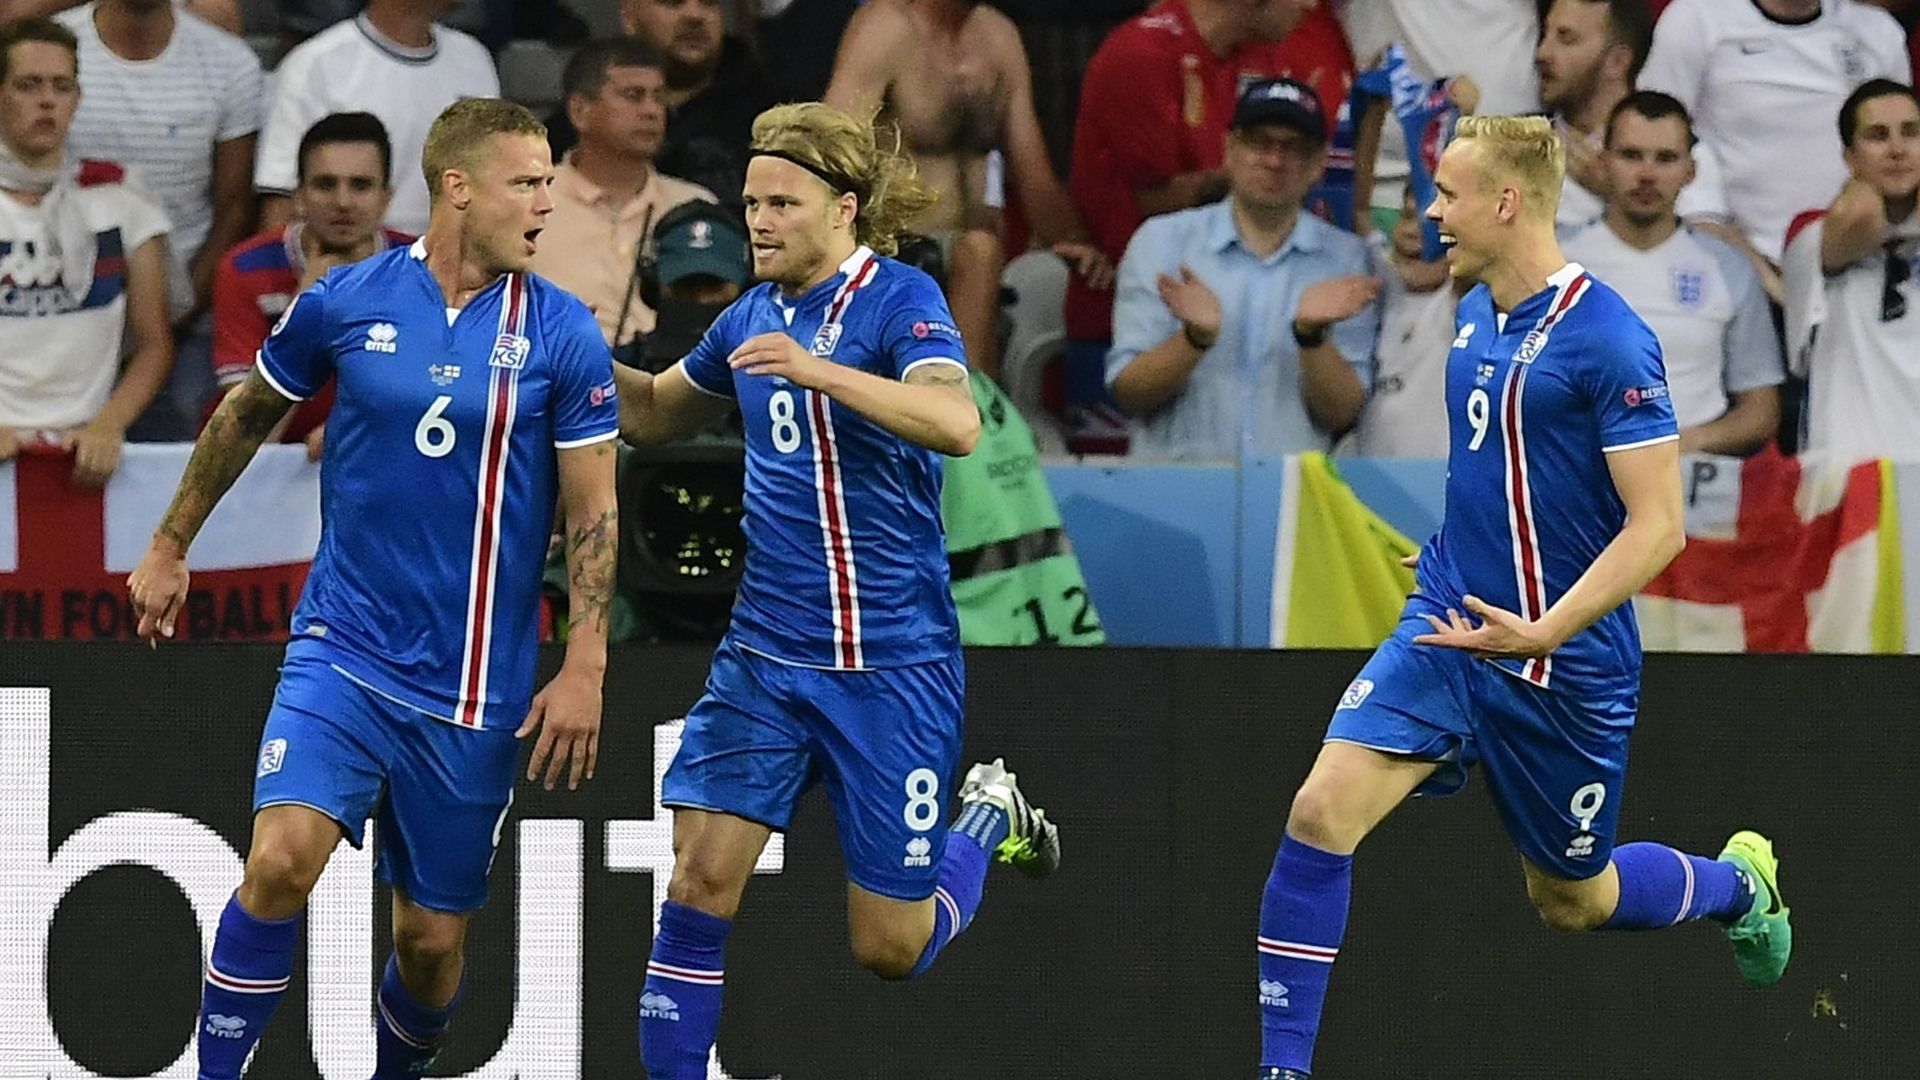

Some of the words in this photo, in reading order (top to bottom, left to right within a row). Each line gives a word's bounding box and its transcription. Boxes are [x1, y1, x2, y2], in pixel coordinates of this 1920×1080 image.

[415, 396, 456, 458] 6
[769, 390, 801, 453] 8
[1467, 389, 1490, 451] 9
[62, 583, 291, 640] FOBALL
[1012, 587, 1103, 643] 12
[904, 768, 939, 831] 8
[1570, 782, 1606, 831] 9
